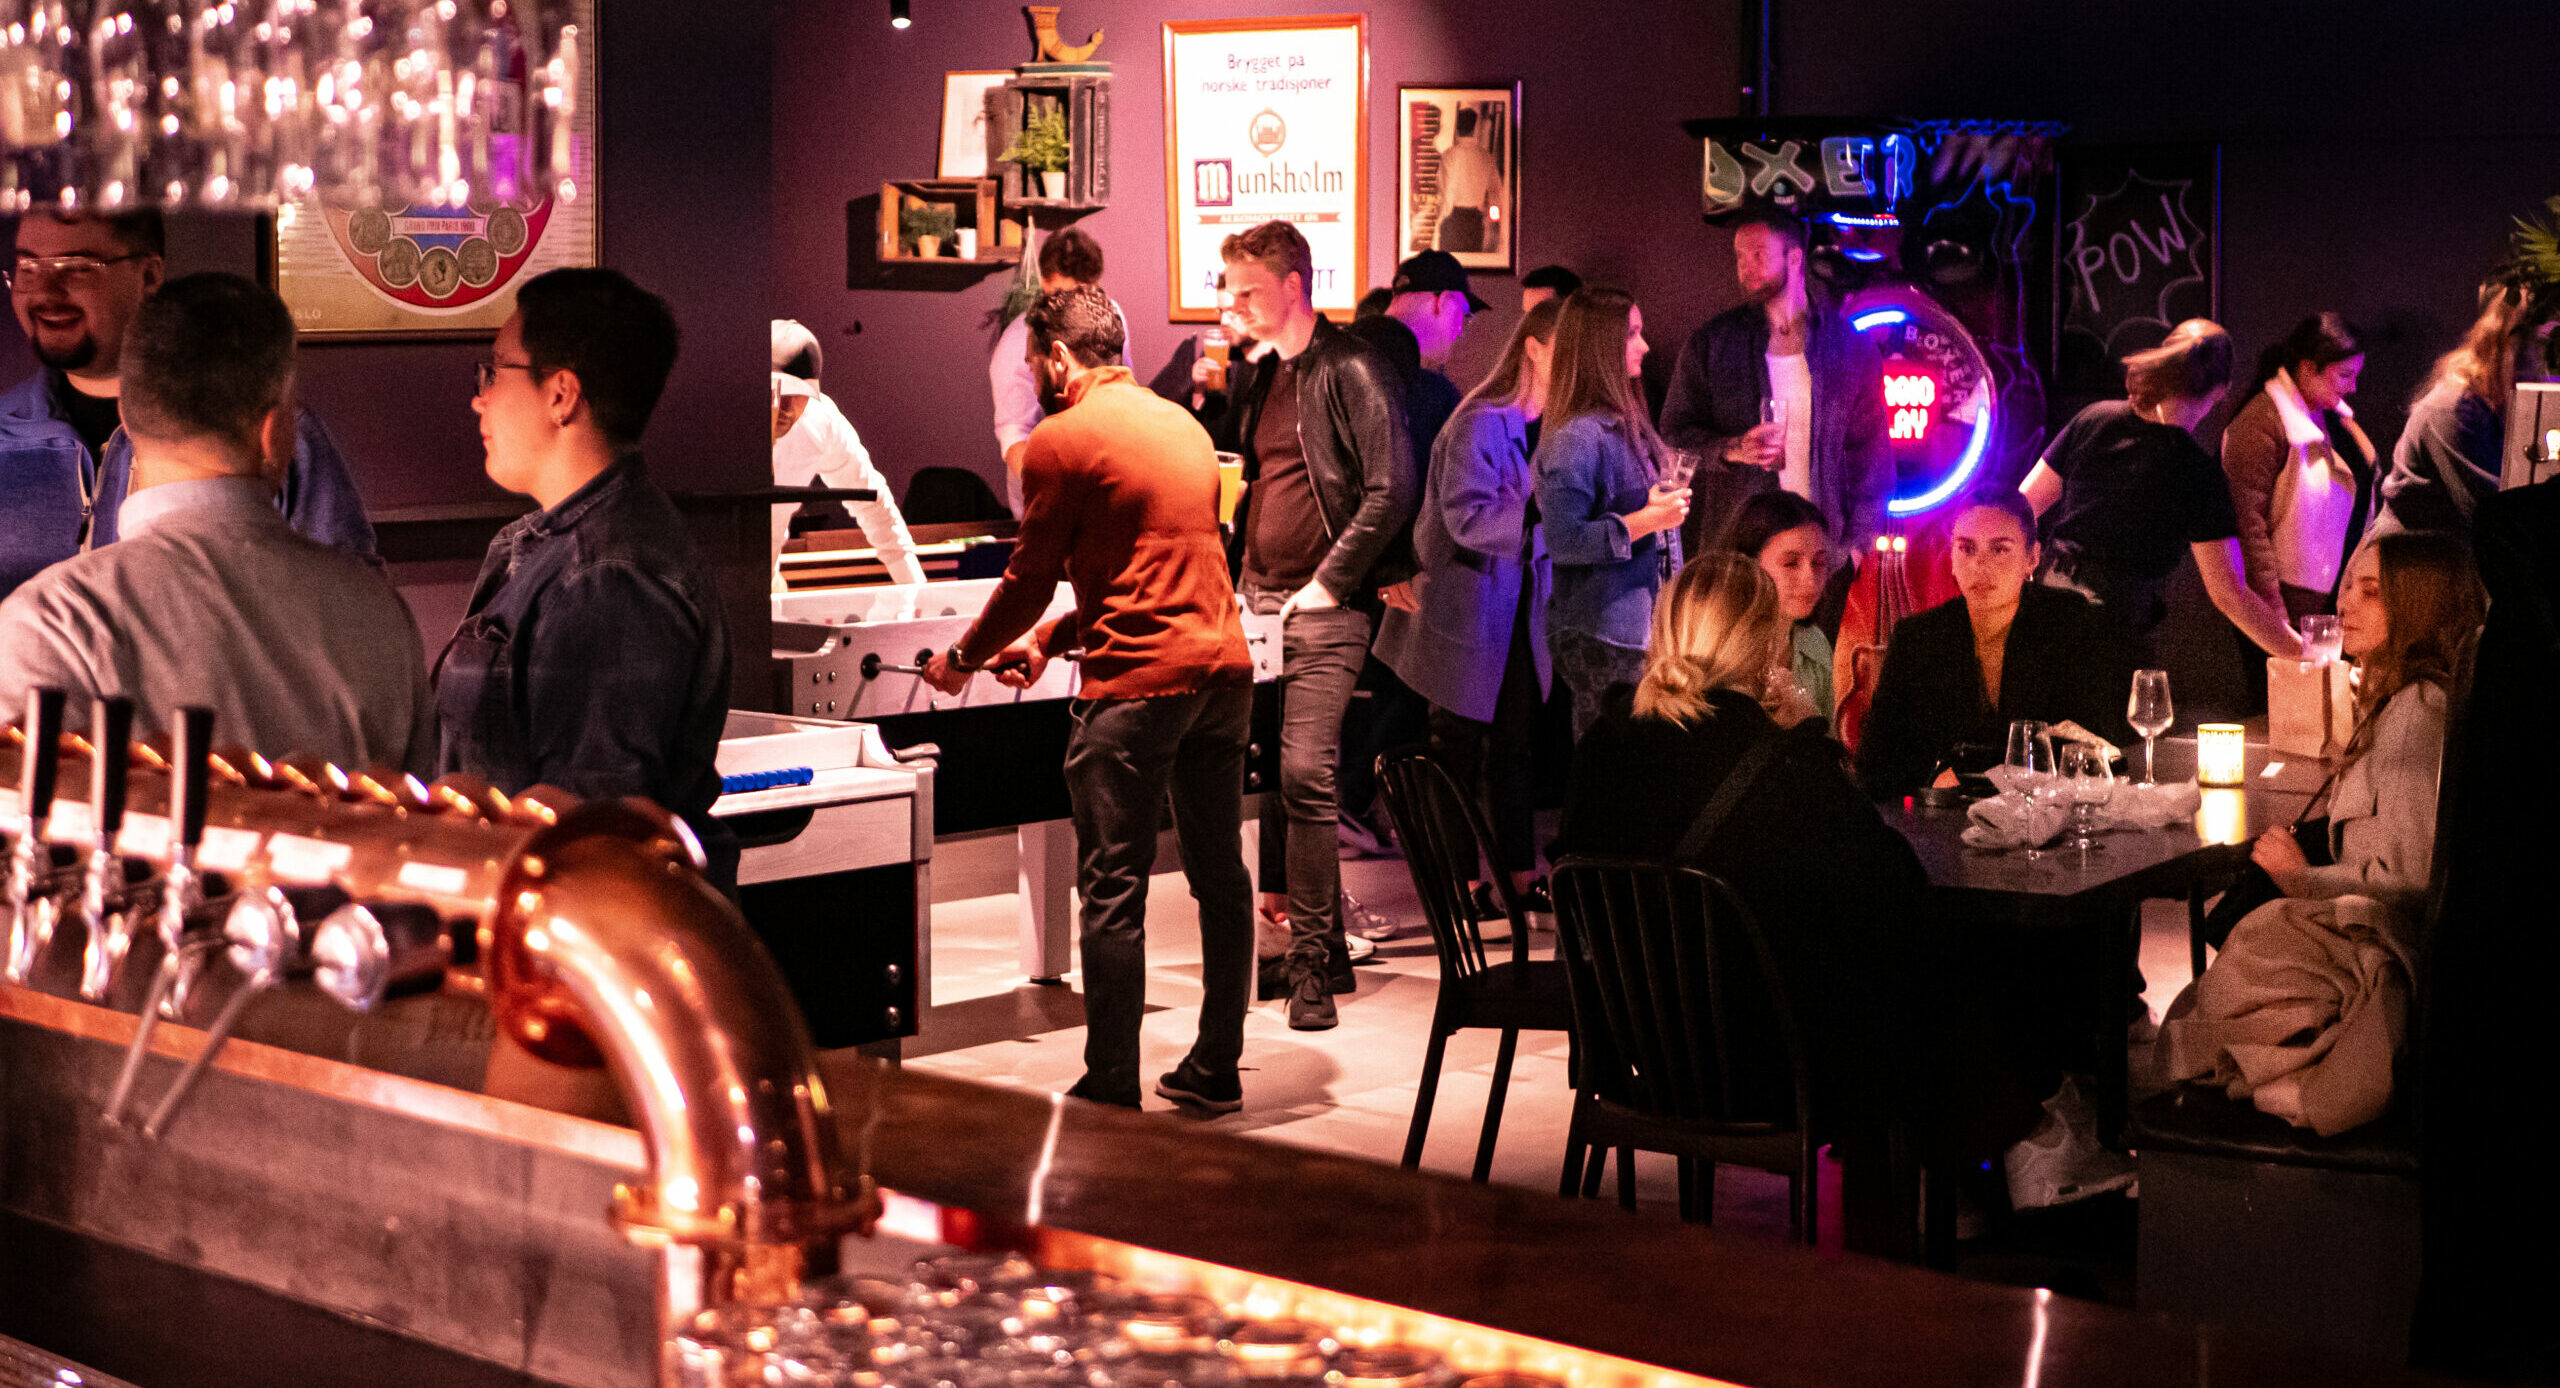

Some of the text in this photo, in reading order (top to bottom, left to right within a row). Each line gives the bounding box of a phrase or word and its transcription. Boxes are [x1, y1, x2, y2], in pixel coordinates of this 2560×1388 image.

[1227, 53, 1281, 74] Brygget
[1201, 76, 1332, 95] norske tradisjoner
[1195, 159, 1343, 206] Munkholm
[2076, 193, 2187, 313] POW
